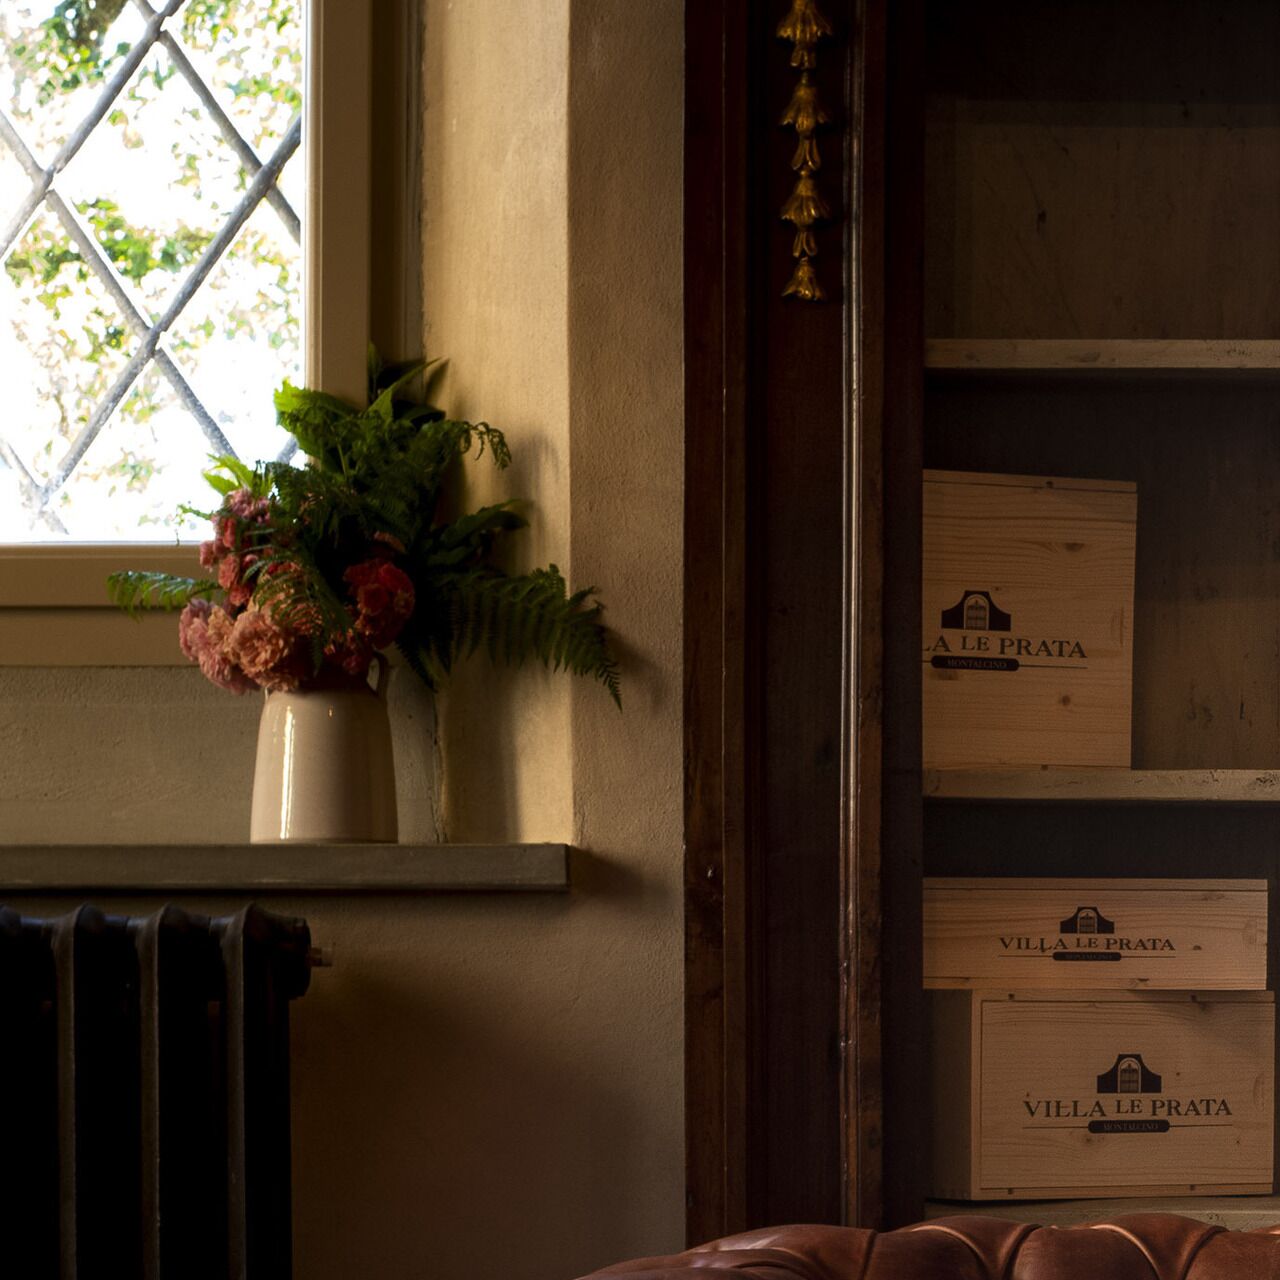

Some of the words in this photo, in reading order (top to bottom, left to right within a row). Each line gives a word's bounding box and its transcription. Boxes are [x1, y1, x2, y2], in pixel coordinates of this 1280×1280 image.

[961, 636, 990, 651] LE
[999, 638, 1088, 659] PRATA
[999, 937, 1070, 951] VILLA
[1076, 937, 1099, 949] LE
[1104, 937, 1176, 951] PRATA
[1023, 1100, 1106, 1118] VILLA
[1115, 1099, 1143, 1114] LE
[1151, 1098, 1233, 1116] PRATA
